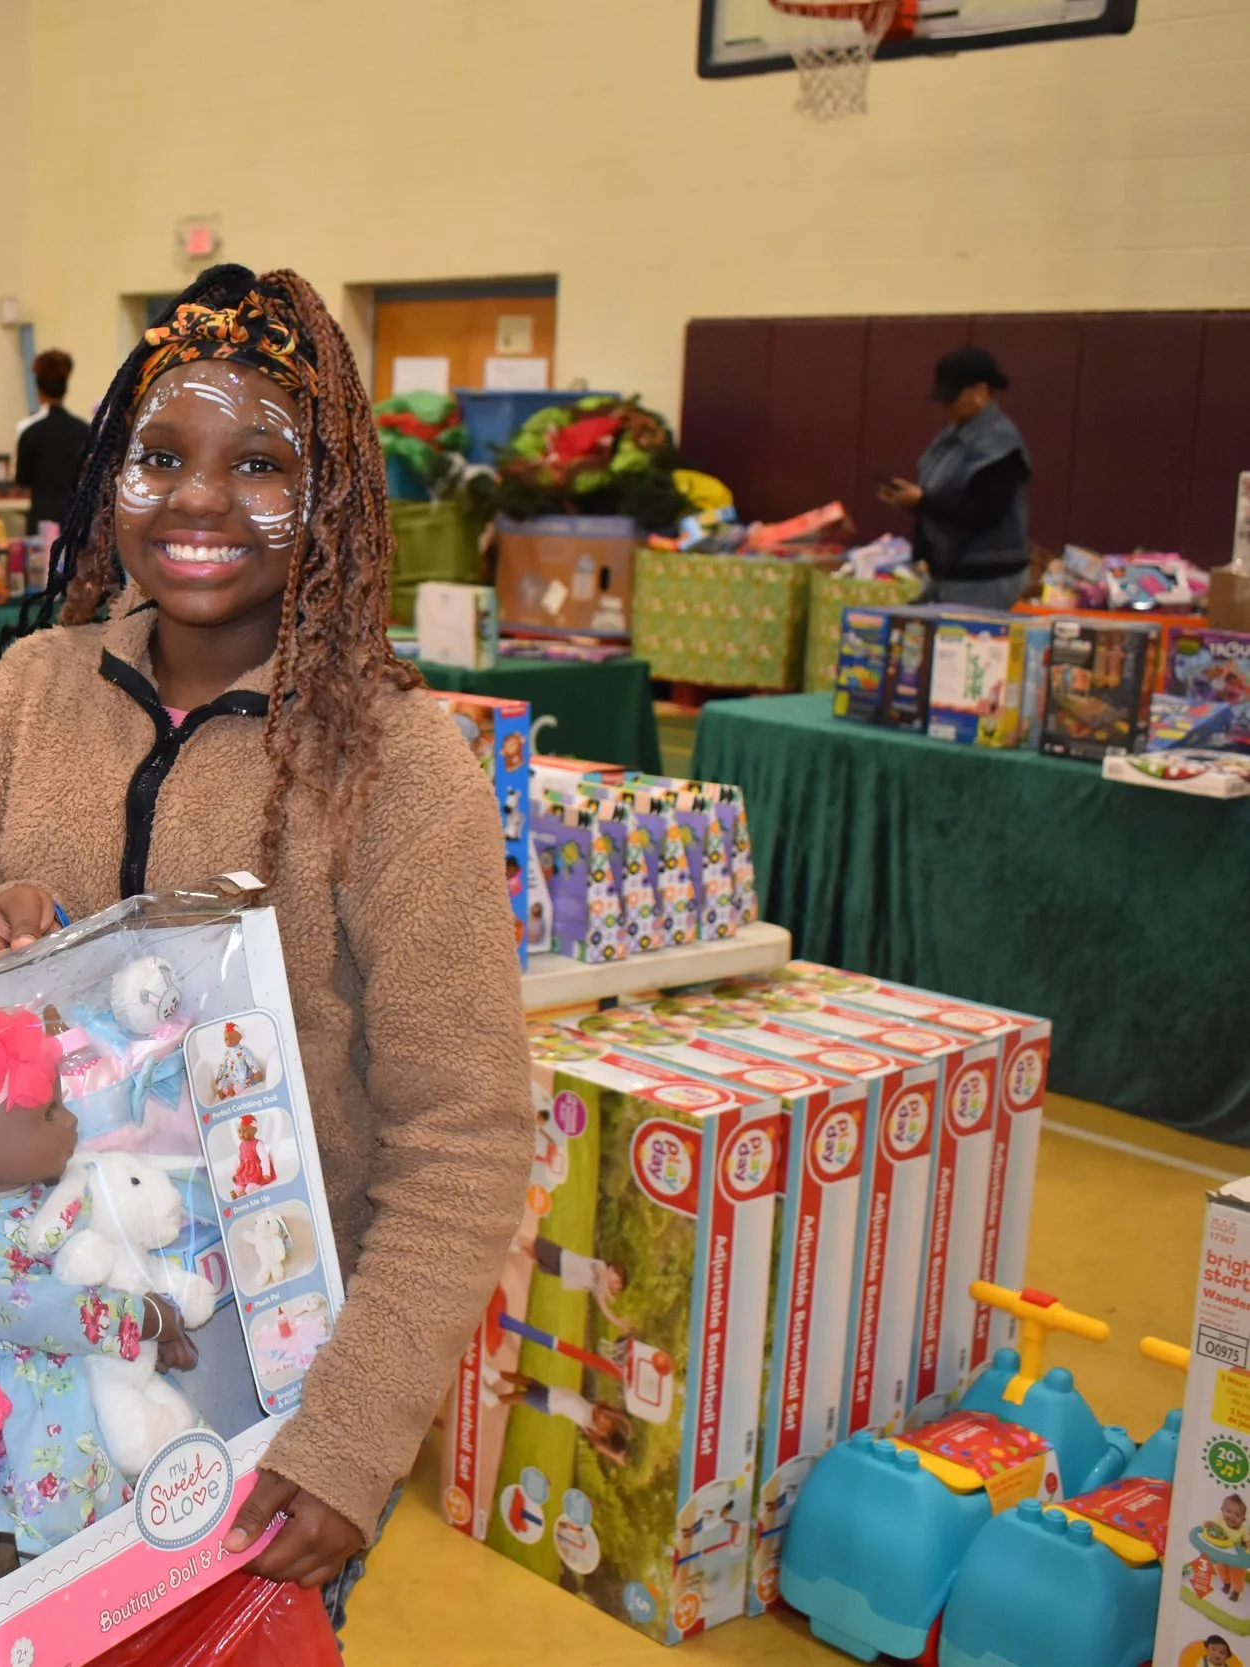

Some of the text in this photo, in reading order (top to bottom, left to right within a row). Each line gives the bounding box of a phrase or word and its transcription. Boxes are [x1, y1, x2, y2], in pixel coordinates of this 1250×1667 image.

[212, 1107, 231, 1120] Perfect
[263, 1094, 278, 1104] Doll
[648, 1139, 666, 1180] day
[260, 1195, 270, 1206] Up
[856, 1193, 886, 1401] Adjustable Basketball Set
[923, 1167, 951, 1370] Adjustable Basketball Set
[700, 1234, 728, 1456] Adjustable Basketball Set
[785, 1215, 815, 1430] Adjustable Basketball Set
[150, 1453, 222, 1526] Sweet
[169, 1458, 188, 1478] my
[99, 1582, 167, 1632] Boutique
[169, 1556, 198, 1588] Doll
[200, 1550, 212, 1569] &
